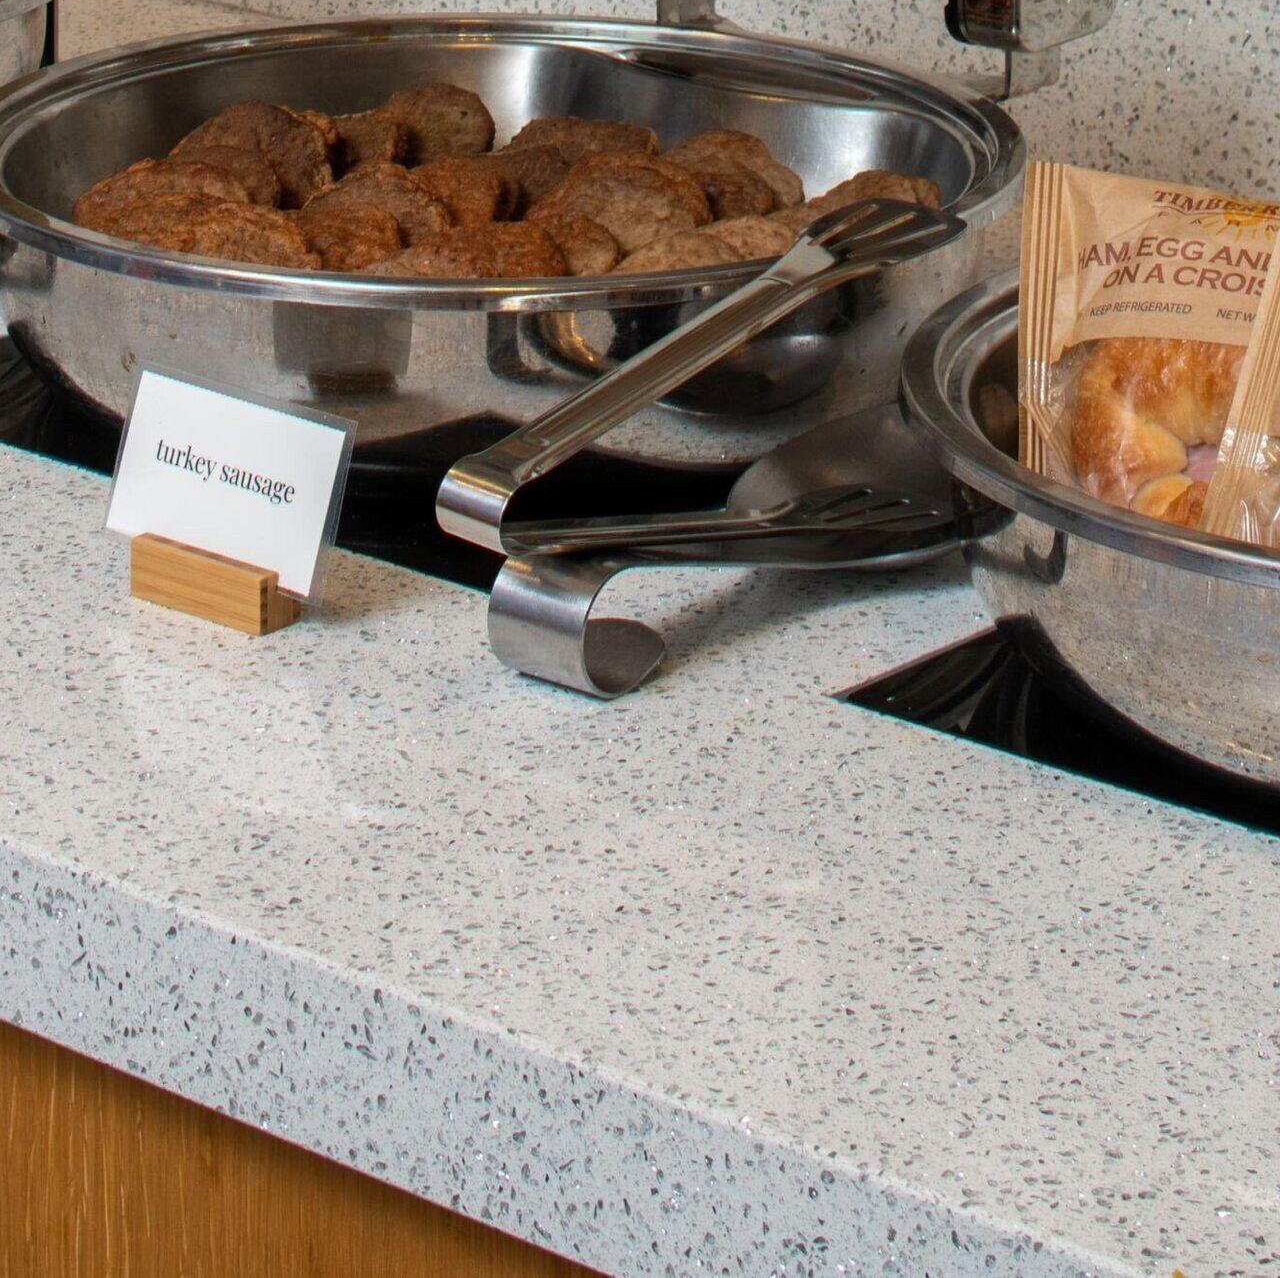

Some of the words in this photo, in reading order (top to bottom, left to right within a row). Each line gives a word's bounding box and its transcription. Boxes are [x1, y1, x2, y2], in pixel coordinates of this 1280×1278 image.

[1135, 236, 1207, 263] EGG
[1143, 263, 1166, 285] A
[1112, 301, 1192, 315] REFRIGERATED
[1215, 308, 1242, 320] NET
[155, 438, 218, 481] turkey
[219, 464, 296, 505] sausage
